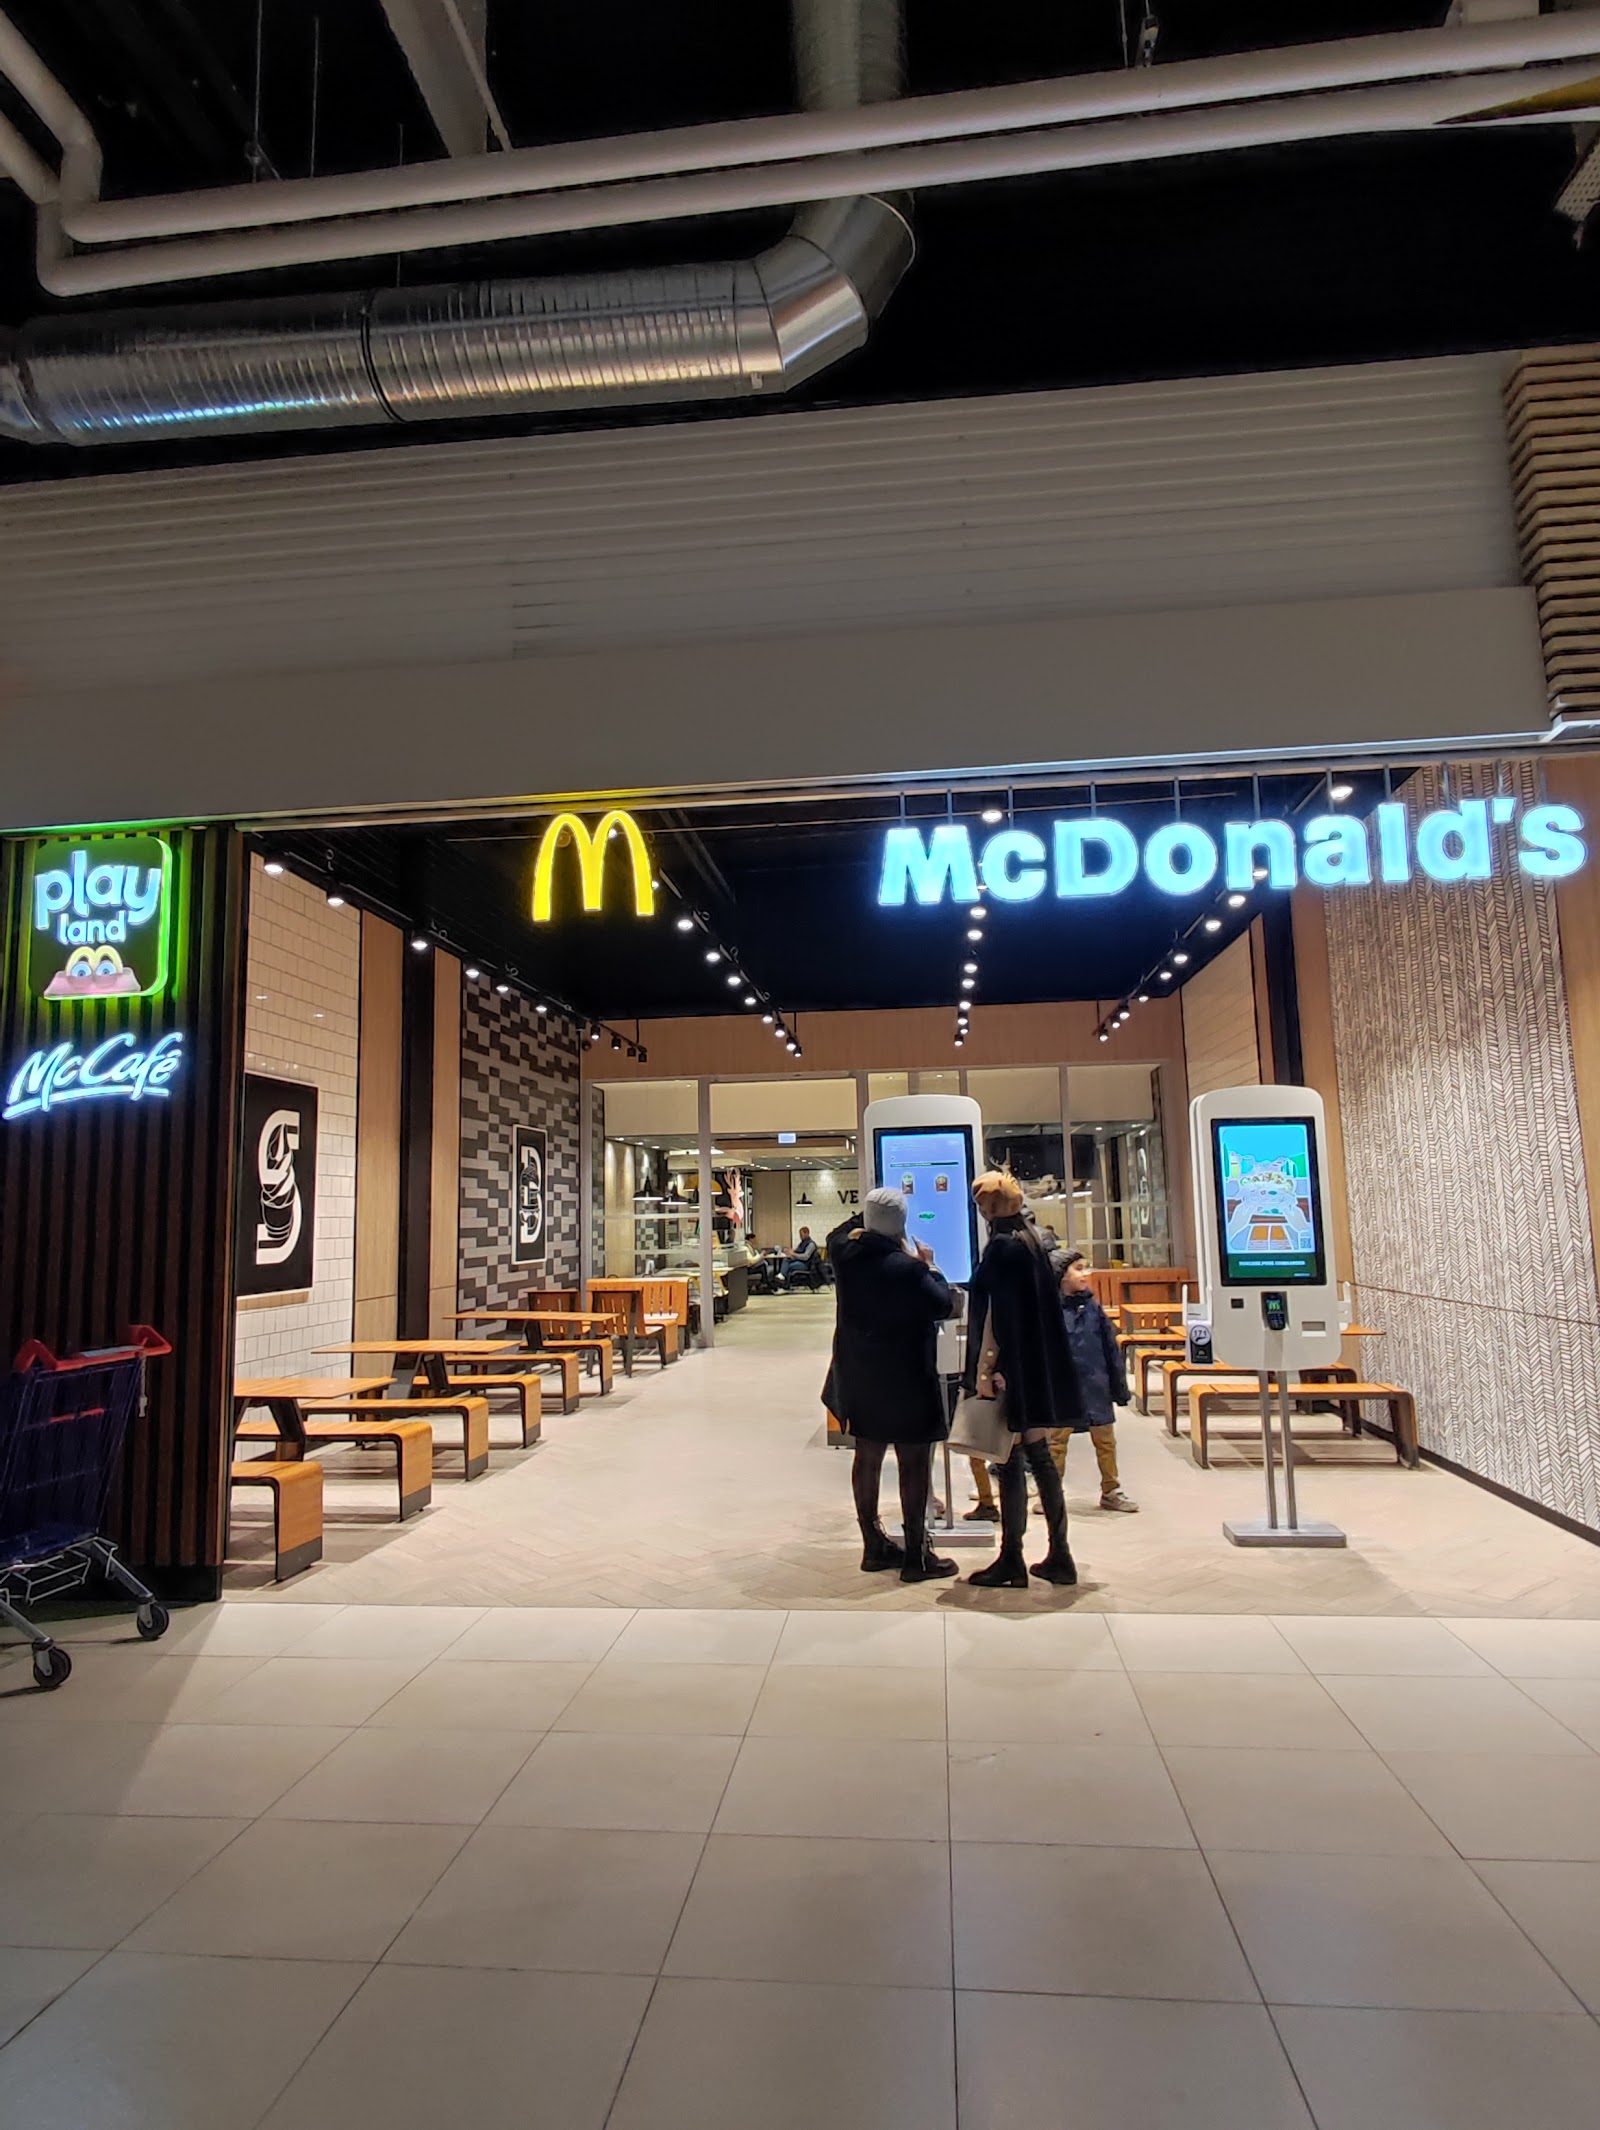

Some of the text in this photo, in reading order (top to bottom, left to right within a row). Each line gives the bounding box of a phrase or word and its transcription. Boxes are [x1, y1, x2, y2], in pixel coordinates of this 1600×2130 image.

[34, 850, 163, 930] play
[877, 796, 1589, 906] McDonald's
[58, 911, 128, 945] land
